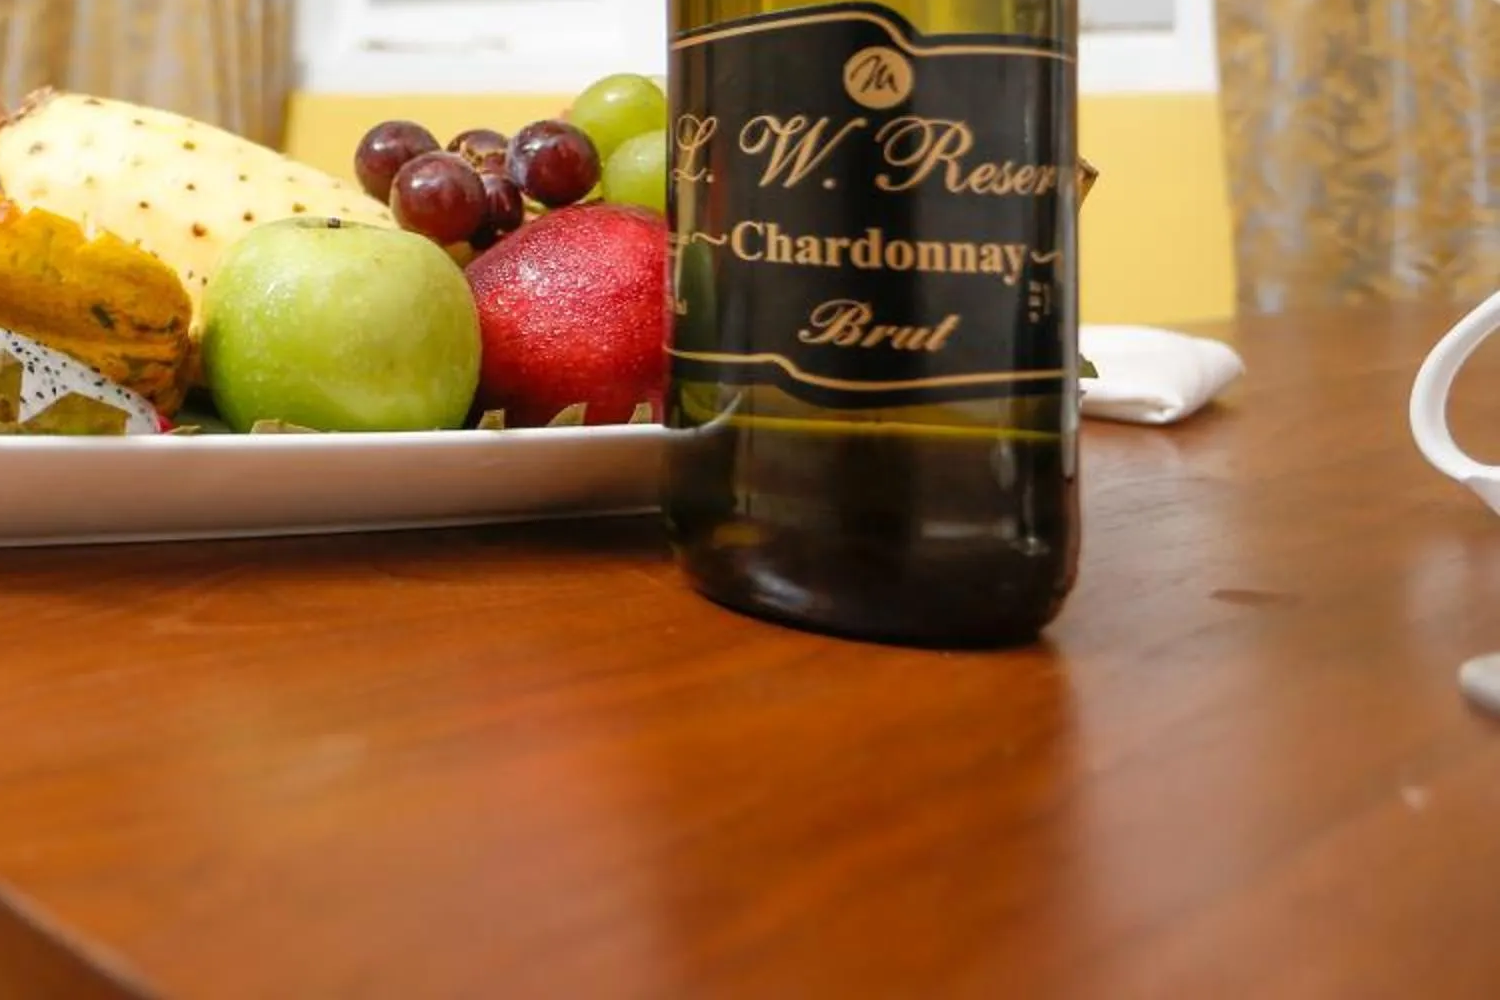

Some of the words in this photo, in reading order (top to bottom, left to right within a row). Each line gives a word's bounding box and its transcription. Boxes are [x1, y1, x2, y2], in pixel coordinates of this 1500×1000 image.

[738, 113, 867, 190] W.
[873, 116, 1058, 196] Reser
[730, 220, 1027, 286] Chardonnay
[798, 298, 961, 352] Brut
